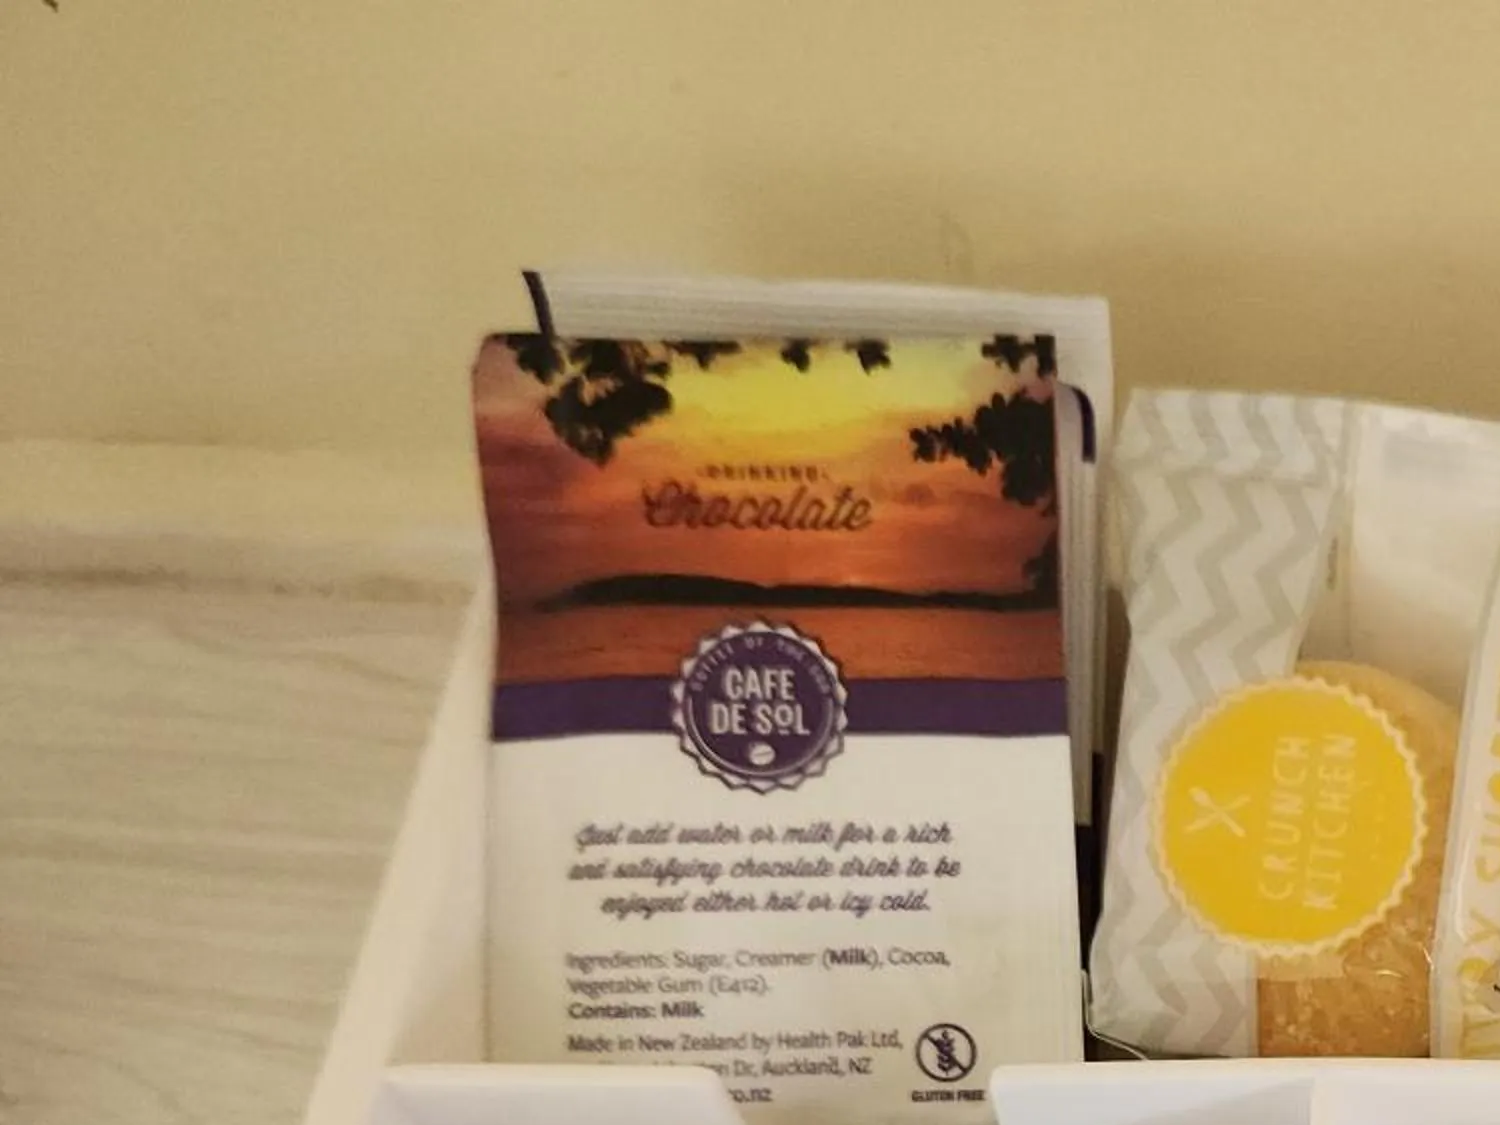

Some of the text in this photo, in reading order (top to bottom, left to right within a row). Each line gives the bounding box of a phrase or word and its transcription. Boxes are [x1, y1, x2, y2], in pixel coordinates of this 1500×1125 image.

[642, 479, 873, 531] Chocolate
[723, 667, 796, 700] CAFE
[710, 702, 748, 735] DE
[1257, 736, 1311, 901] CRUNCH
[1302, 733, 1357, 911] KITCHEN
[627, 822, 675, 845] add
[678, 822, 741, 845] water
[750, 825, 775, 844] or
[782, 821, 833, 845] milk
[834, 821, 874, 852] for
[881, 827, 898, 844] a
[904, 821, 953, 844] rich
[567, 855, 962, 888] and satisfying chocolate drink to be
[692, 889, 759, 912] either
[764, 889, 804, 912] hot
[807, 891, 833, 912] or
[839, 888, 874, 919] icy
[736, 950, 816, 968] Creamer
[566, 975, 654, 1000] Vegetable
[658, 975, 704, 995] Gum
[567, 1001, 657, 1020] Contains:
[567, 1033, 614, 1052] Made
[618, 1034, 635, 1051] in
[639, 1034, 675, 1052] New
[678, 1031, 747, 1051] Zealand
[752, 1031, 772, 1056] by
[777, 1030, 830, 1051] Health
[836, 1030, 866, 1049] Pak
[849, 1057, 874, 1075] NZ
[957, 1089, 986, 1102] FREE
